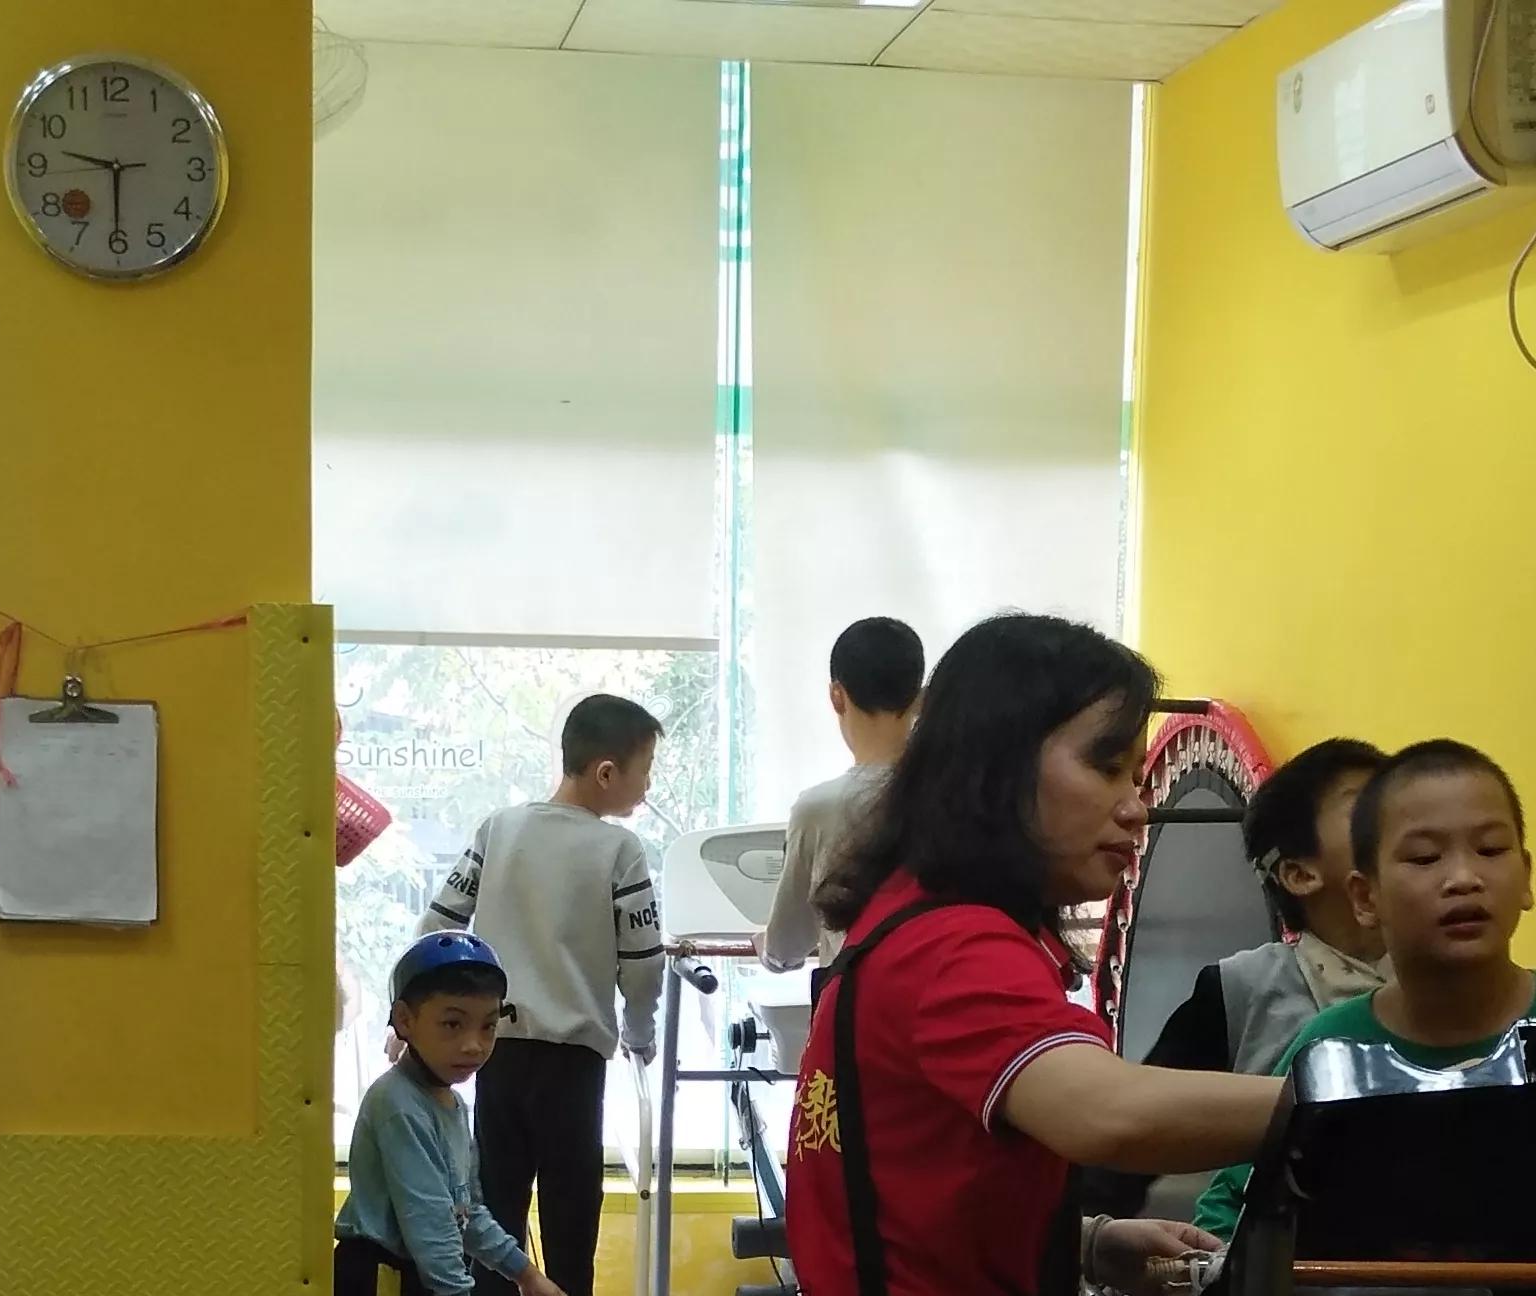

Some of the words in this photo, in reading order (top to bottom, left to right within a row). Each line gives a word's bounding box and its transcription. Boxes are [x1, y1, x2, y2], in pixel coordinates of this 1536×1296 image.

[68, 86, 88, 111] 11
[100, 76, 130, 102] 12
[150, 88, 157, 112] 1
[40, 114, 66, 139] 10
[171, 118, 191, 143] 2
[27, 152, 48, 177] 9
[186, 157, 206, 182] 3
[41, 193, 61, 217] 8
[174, 196, 192, 221] 4
[71, 221, 90, 246] 7
[108, 230, 128, 254] 6
[146, 223, 166, 248] 5
